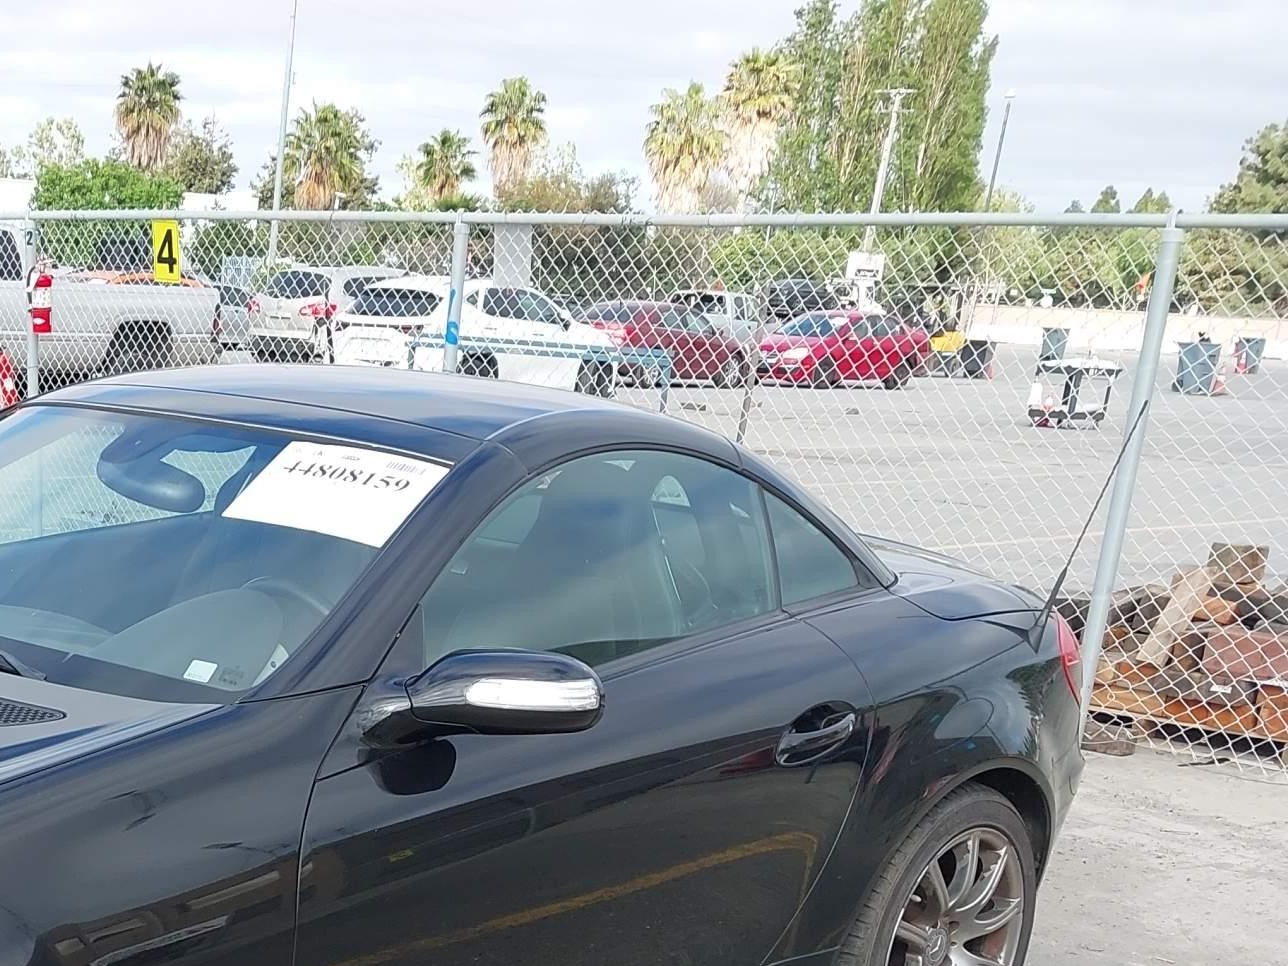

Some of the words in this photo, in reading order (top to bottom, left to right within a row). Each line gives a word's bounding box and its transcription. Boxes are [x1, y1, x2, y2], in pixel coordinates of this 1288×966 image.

[26, 230, 34, 246] 2
[157, 228, 177, 274] 4
[283, 459, 411, 492] 44808159
